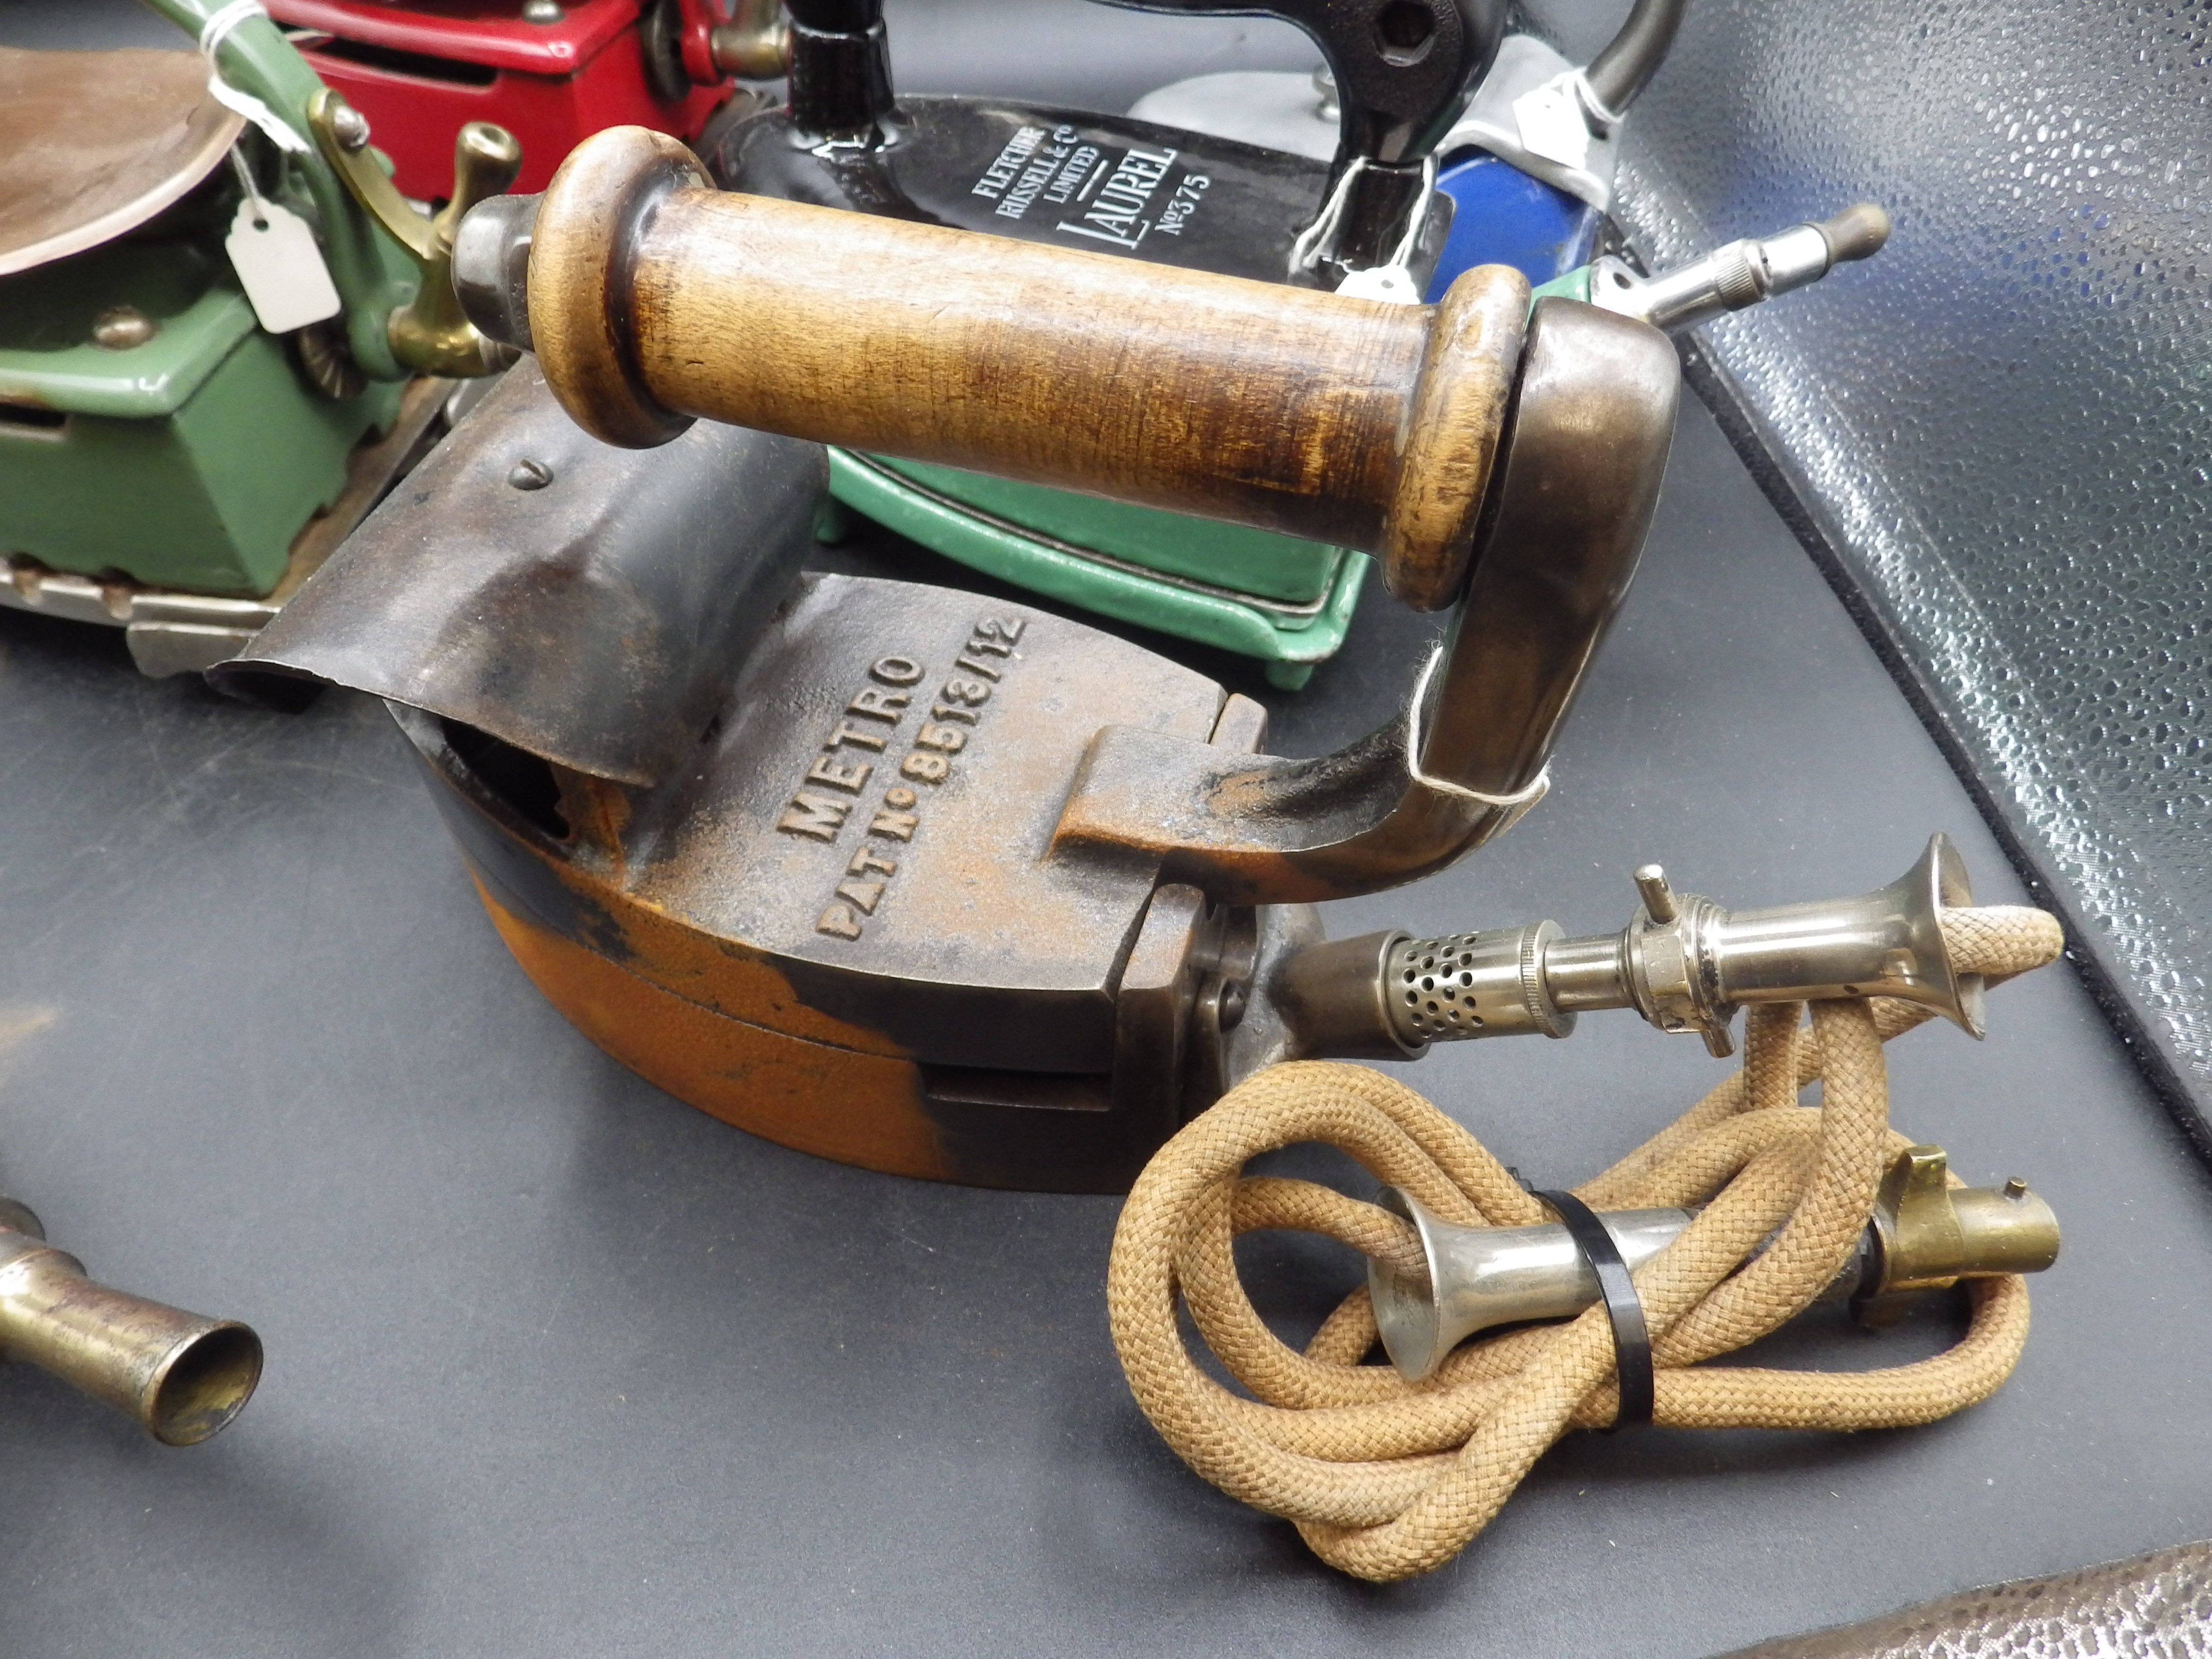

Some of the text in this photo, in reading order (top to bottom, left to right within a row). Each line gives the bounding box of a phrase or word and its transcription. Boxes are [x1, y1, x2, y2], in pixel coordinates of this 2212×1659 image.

[971, 126, 1046, 199] FLETCHER
[995, 157, 1060, 219] RUSSELL
[1043, 145, 1070, 159] &
[1043, 145, 1100, 204] LIMITED
[1056, 147, 1178, 250] LAUREL
[776, 655, 925, 842] METRO
[816, 846, 897, 941] PAT
